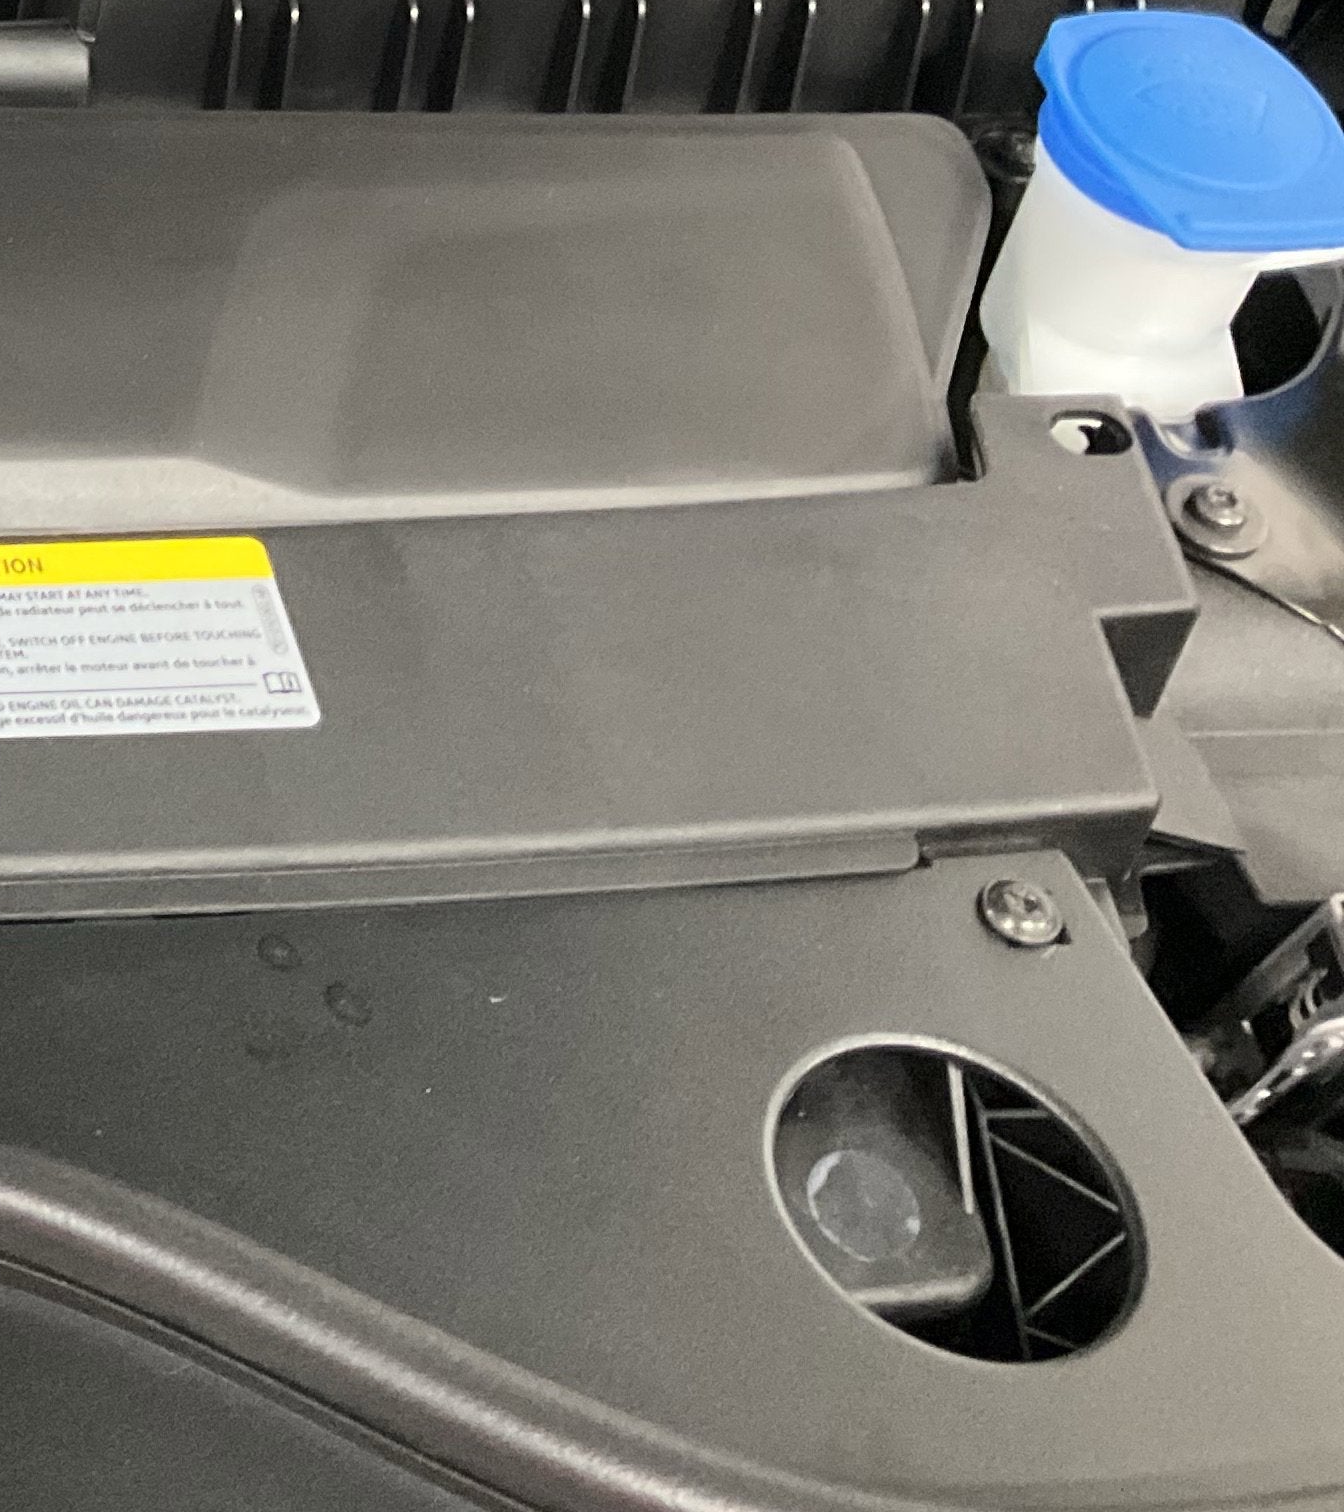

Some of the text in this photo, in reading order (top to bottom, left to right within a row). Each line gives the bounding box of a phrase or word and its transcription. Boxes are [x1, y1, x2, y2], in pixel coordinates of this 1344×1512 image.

[25, 590, 64, 601] START
[66, 589, 82, 600] AT
[84, 588, 110, 599] ANY
[8, 636, 58, 648] SWITCH
[60, 635, 85, 646] OFF
[88, 633, 137, 645] ENGINE
[140, 631, 191, 643] BEFORE
[193, 628, 262, 641] TOUCHING
